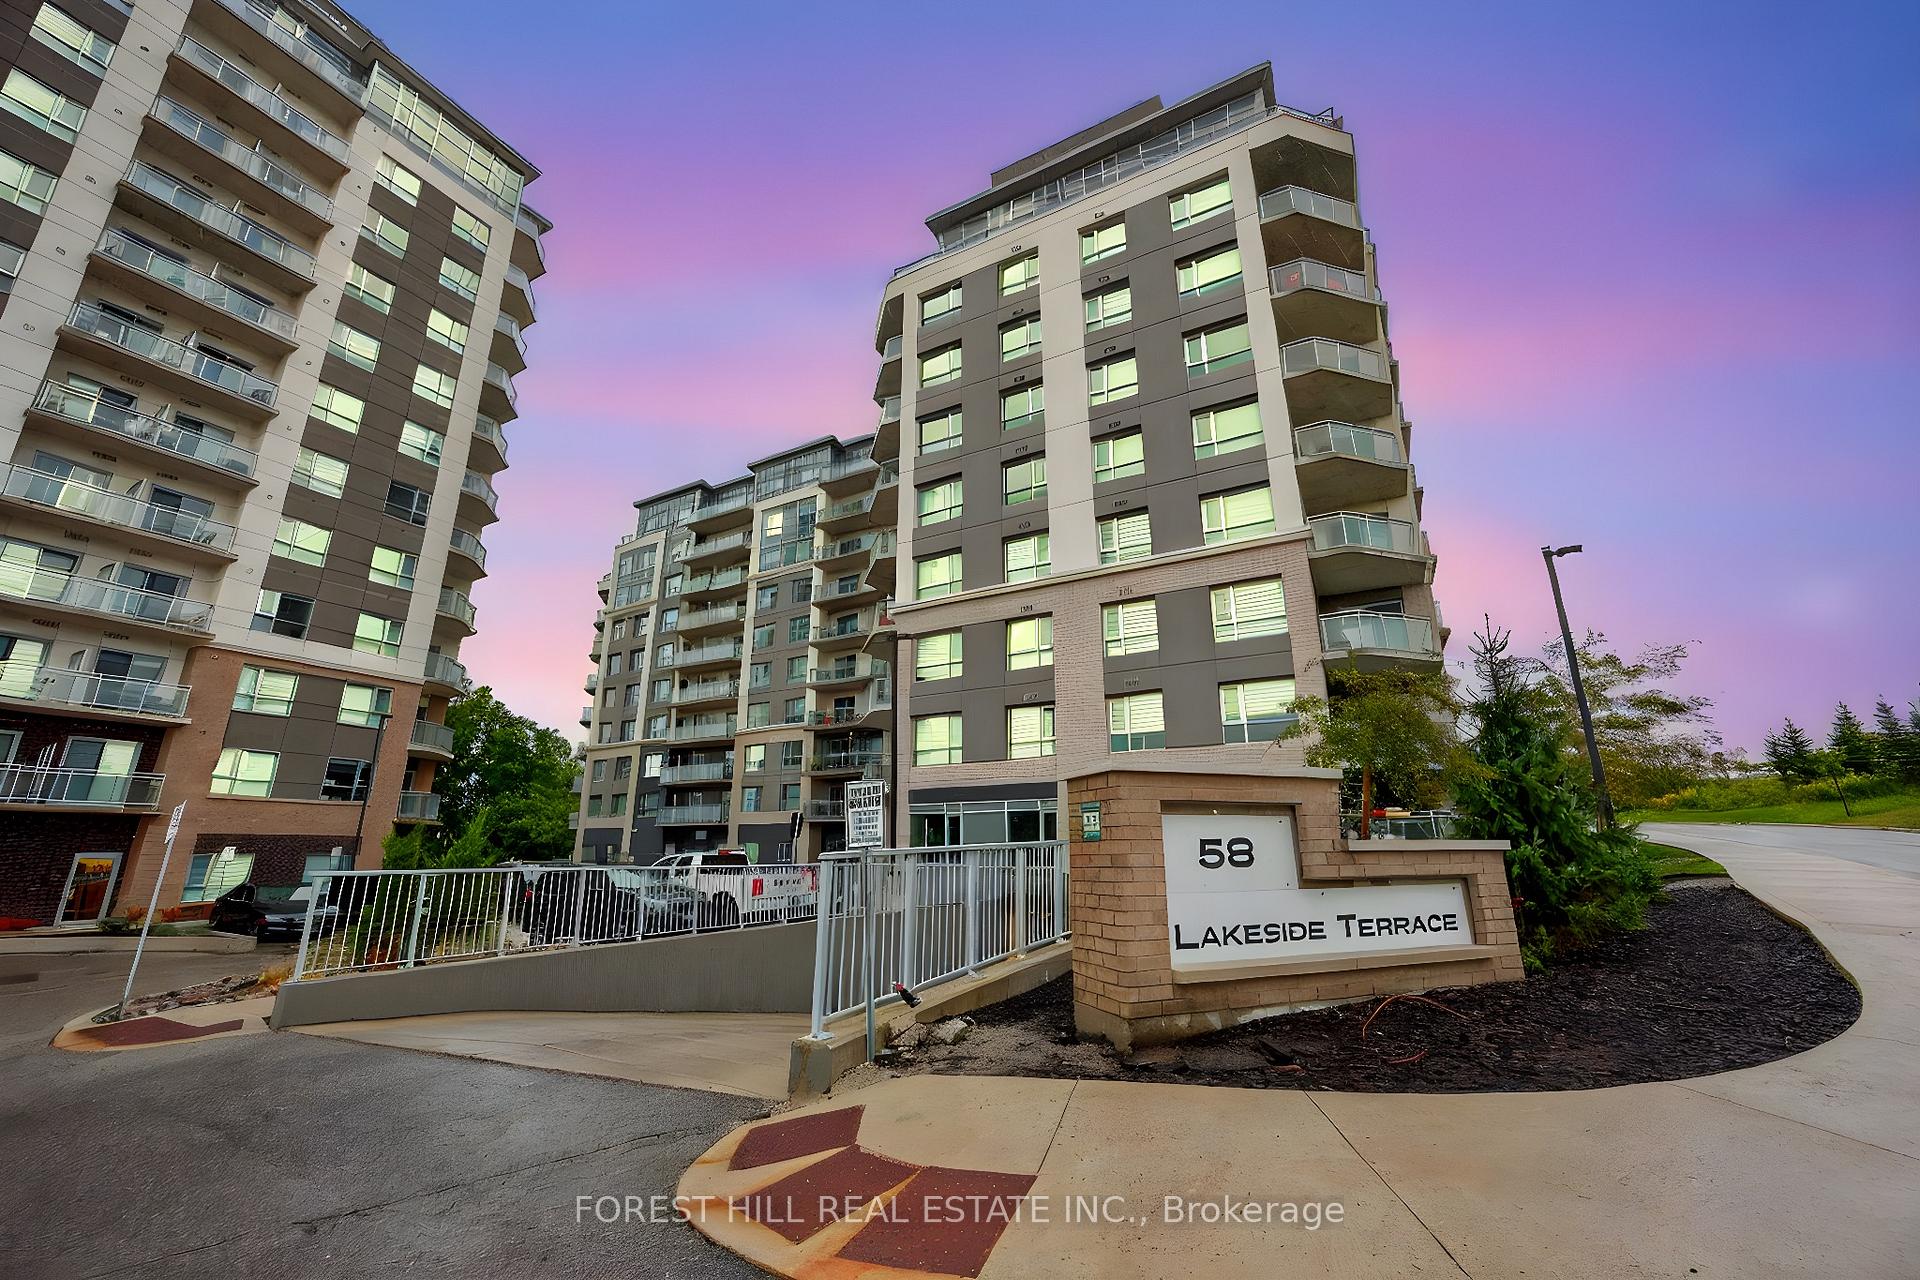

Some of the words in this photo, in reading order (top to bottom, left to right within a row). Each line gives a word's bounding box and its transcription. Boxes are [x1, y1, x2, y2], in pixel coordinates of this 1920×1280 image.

[1198, 837, 1255, 869] 58
[1174, 921, 1327, 950] LAKESIDE
[1336, 913, 1459, 938] TERRACE
